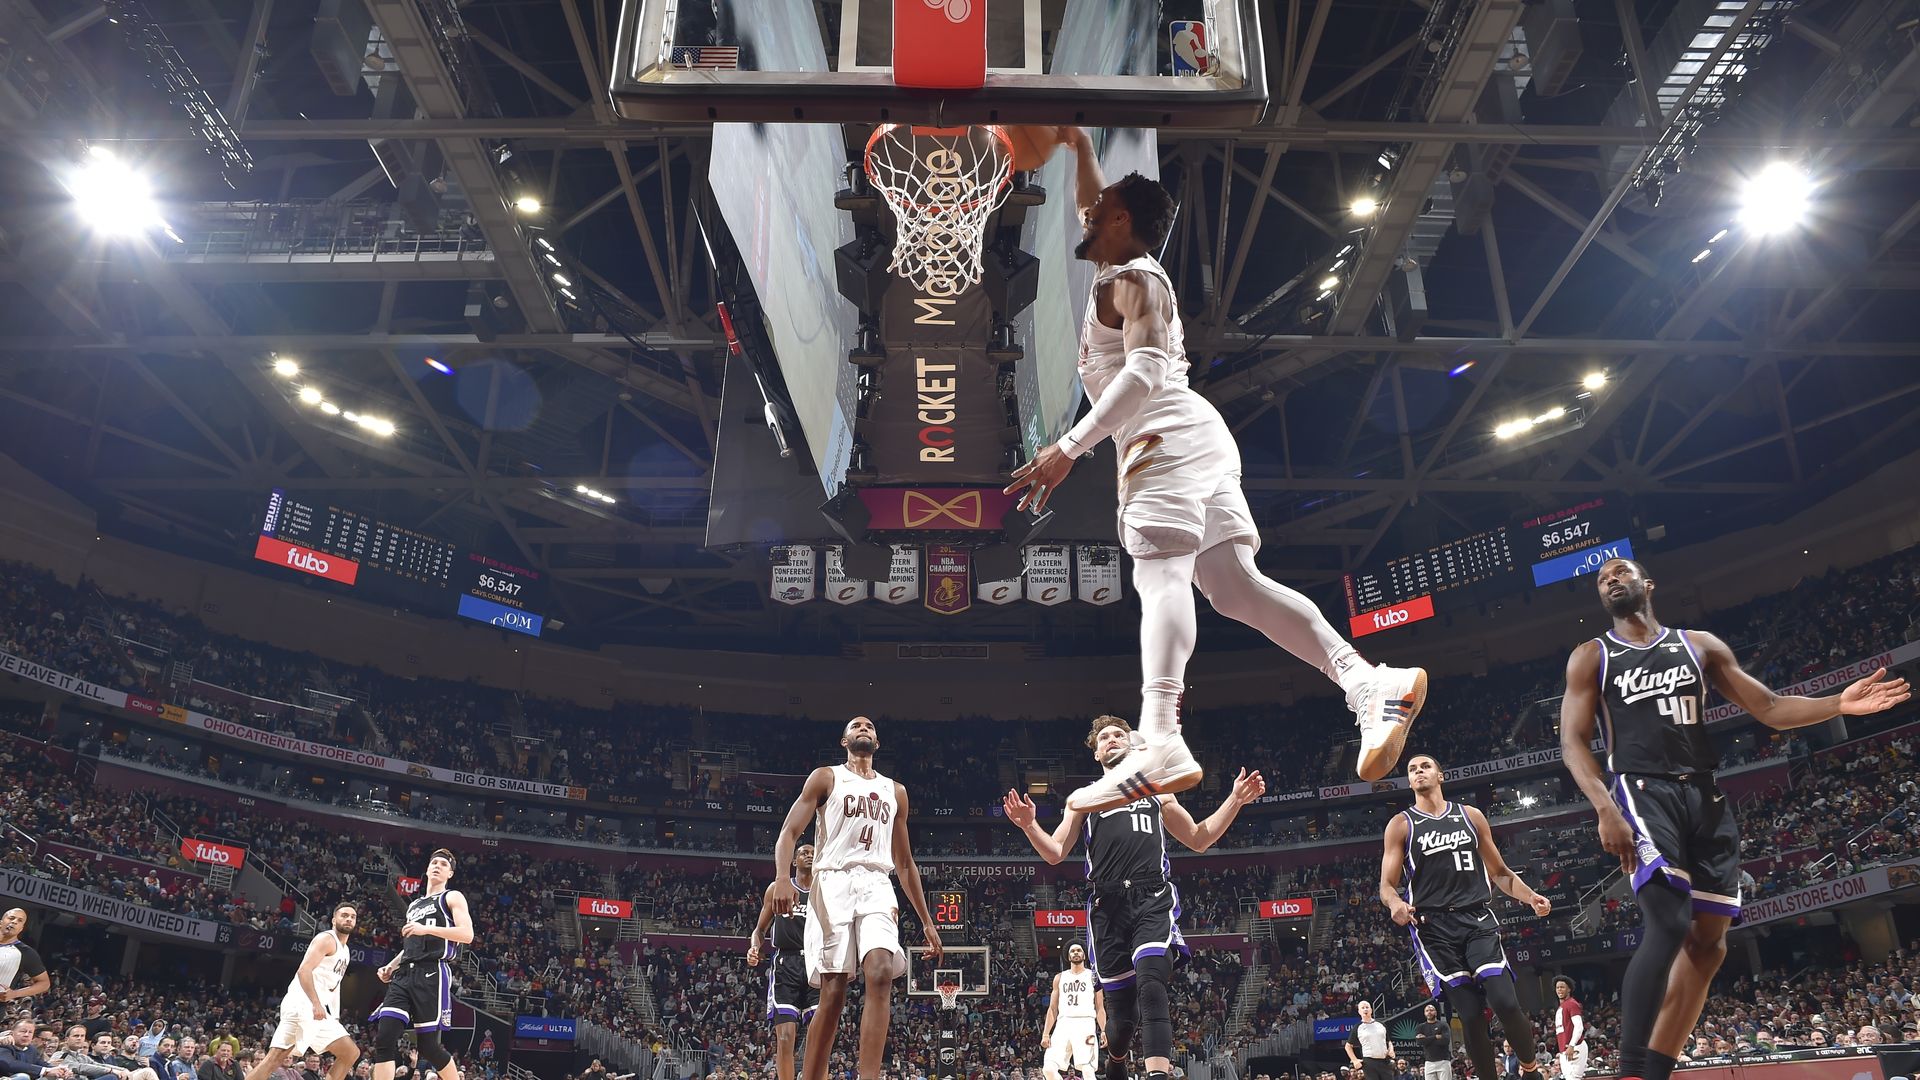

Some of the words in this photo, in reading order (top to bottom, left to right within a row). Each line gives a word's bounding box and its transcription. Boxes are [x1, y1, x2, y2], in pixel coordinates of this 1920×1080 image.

[918, 358, 956, 462] ROCKET
[1542, 522, 1590, 549] $6,547
[287, 548, 329, 574] fubo
[941, 557, 955, 565] NBA
[774, 567, 814, 575] CONFERENCE
[929, 565, 967, 573] CHAMPIONS
[479, 574, 521, 596] $6,547
[1373, 609, 1409, 629] fubo
[18, 661, 57, 685] HAVE
[59, 676, 73, 689] IT
[74, 684, 105, 701] ALL.
[1613, 664, 1696, 705] Kings
[132, 699, 152, 711] Ohio
[1656, 695, 1698, 725] 40
[203, 718, 385, 768] OHIOCATRENTALSTORE.COM
[1444, 771, 1460, 782] OR
[1463, 763, 1504, 778] SMALL
[1505, 757, 1526, 769] WE
[1527, 749, 1562, 765] HAVE
[454, 773, 475, 784] BIG
[478, 776, 496, 788] OR
[499, 779, 539, 794] SMALL
[542, 784, 561, 797] WE
[1279, 790, 1316, 801] KNOW.
[706, 802, 722, 810] TOL
[746, 804, 772, 812] FOULS
[844, 794, 891, 825] CAVS
[968, 807, 983, 816] 3Q
[1130, 813, 1153, 834] 10
[482, 839, 499, 847] M125
[859, 824, 873, 851] 4
[1417, 830, 1472, 855] Kings
[196, 843, 229, 863] fubo
[1451, 850, 1475, 871] 13
[956, 866, 1002, 876] GENDS
[1005, 866, 1036, 876] CLUB
[6, 873, 35, 897] YOU
[38, 883, 78, 912] NEED,
[82, 894, 123, 918] WHEN
[121, 904, 146, 925] YOU
[148, 913, 184, 933] NEED
[187, 922, 201, 936] IT.
[941, 894, 961, 904] 7:37
[591, 901, 620, 915] fubo
[936, 904, 959, 922] 20
[1272, 902, 1300, 915] fubo
[1047, 912, 1075, 925] fubo
[219, 932, 230, 943] 56
[259, 935, 274, 949] 20
[1624, 934, 1636, 946] 72
[351, 950, 365, 962] 20
[1516, 950, 1530, 961] 89
[1063, 981, 1086, 993] CAVS
[1068, 995, 1079, 1006] 31
[549, 1024, 573, 1033] ULTRA
